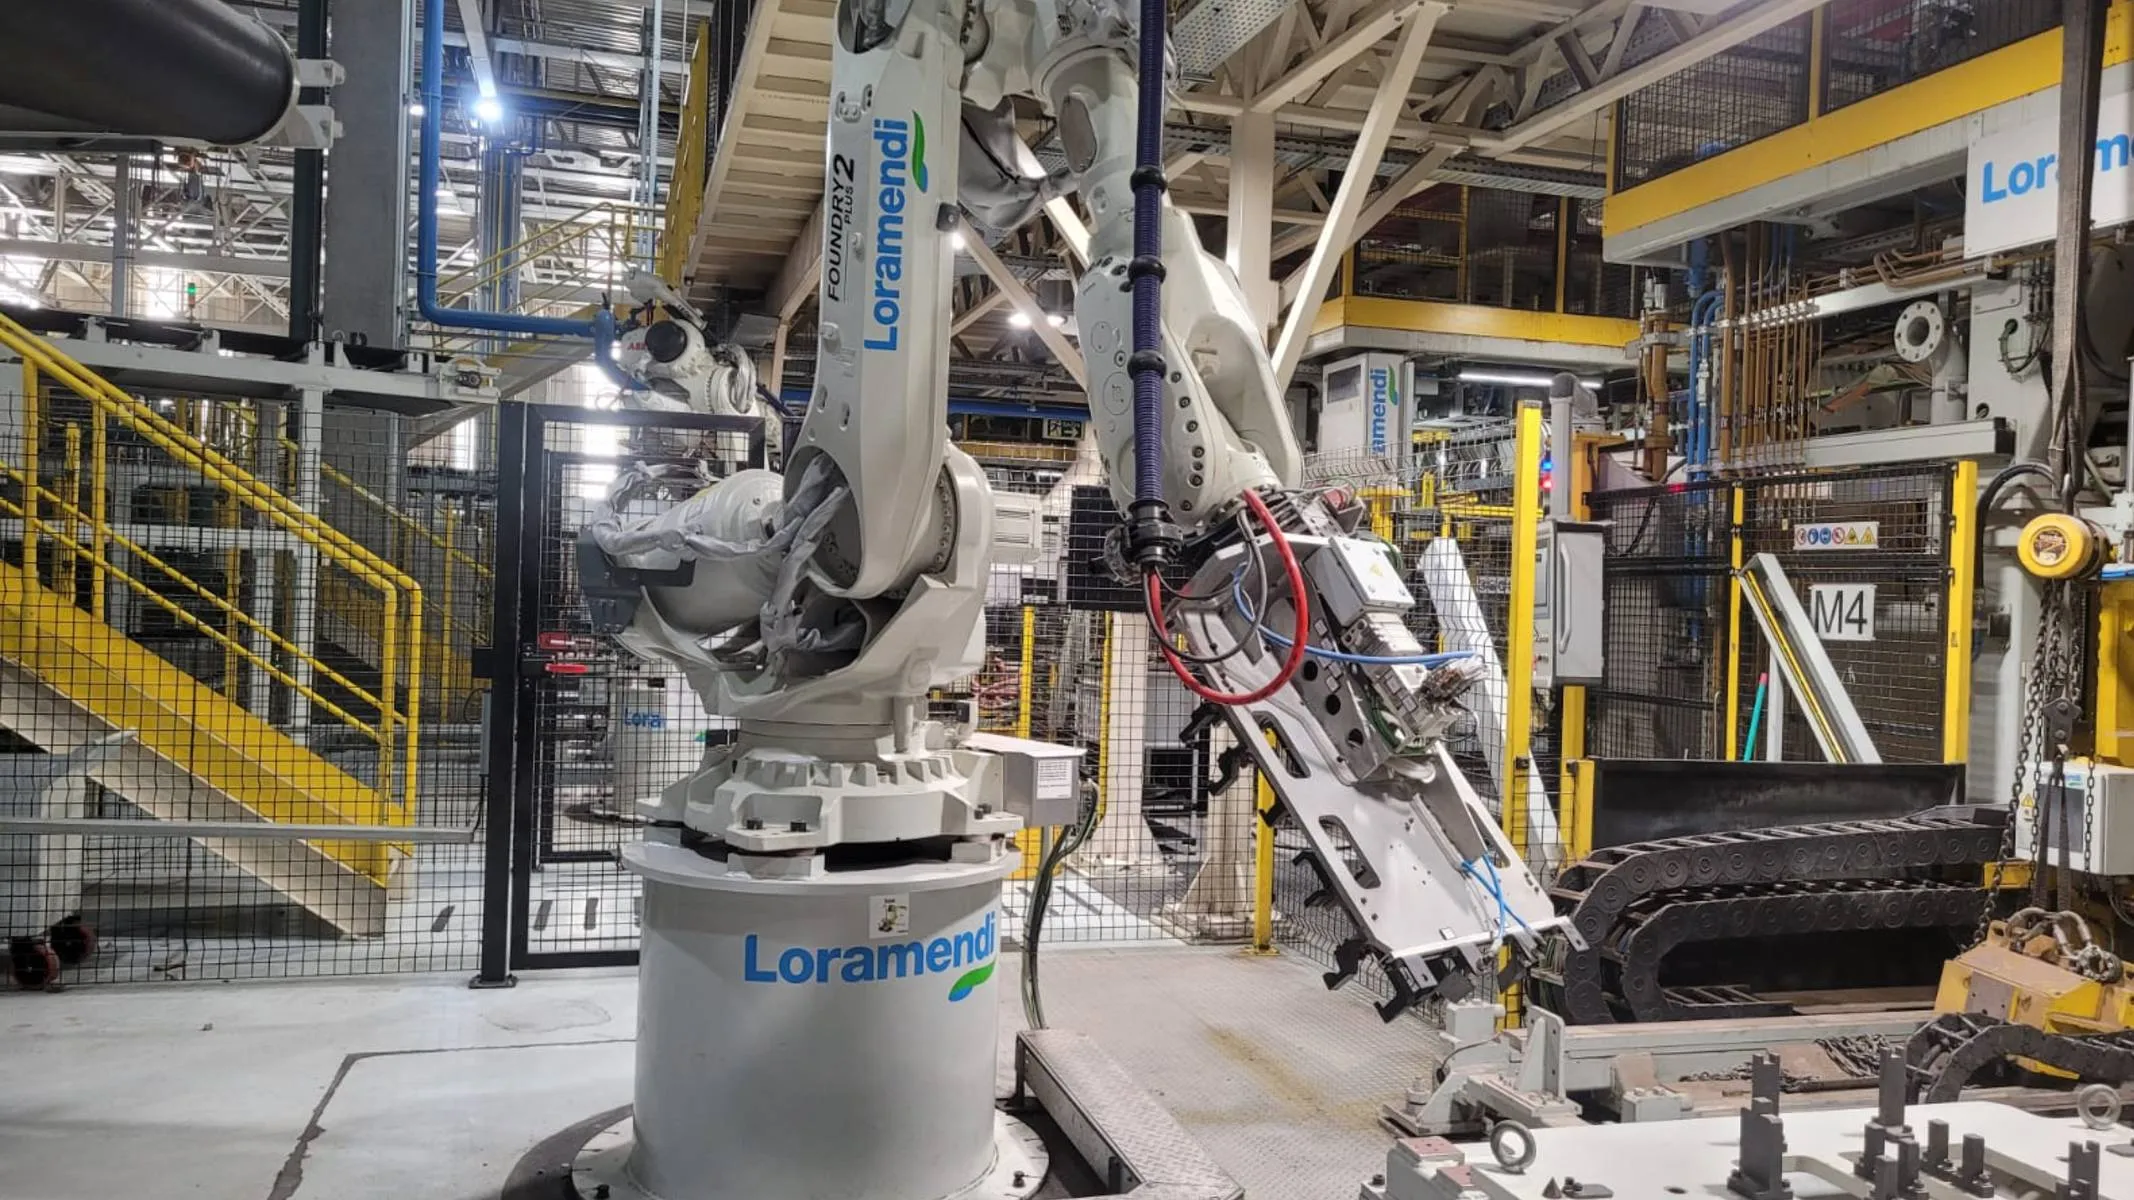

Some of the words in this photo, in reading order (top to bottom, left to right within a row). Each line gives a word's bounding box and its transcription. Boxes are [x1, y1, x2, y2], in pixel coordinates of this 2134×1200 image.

[833, 153, 854, 182] 2
[1982, 133, 2134, 205] Lorm
[828, 177, 844, 302] FOUNDRY
[844, 186, 854, 225] PLUS
[863, 118, 908, 351] Loramendi
[1815, 590, 1868, 635] M4
[744, 911, 997, 984] Loramendi
